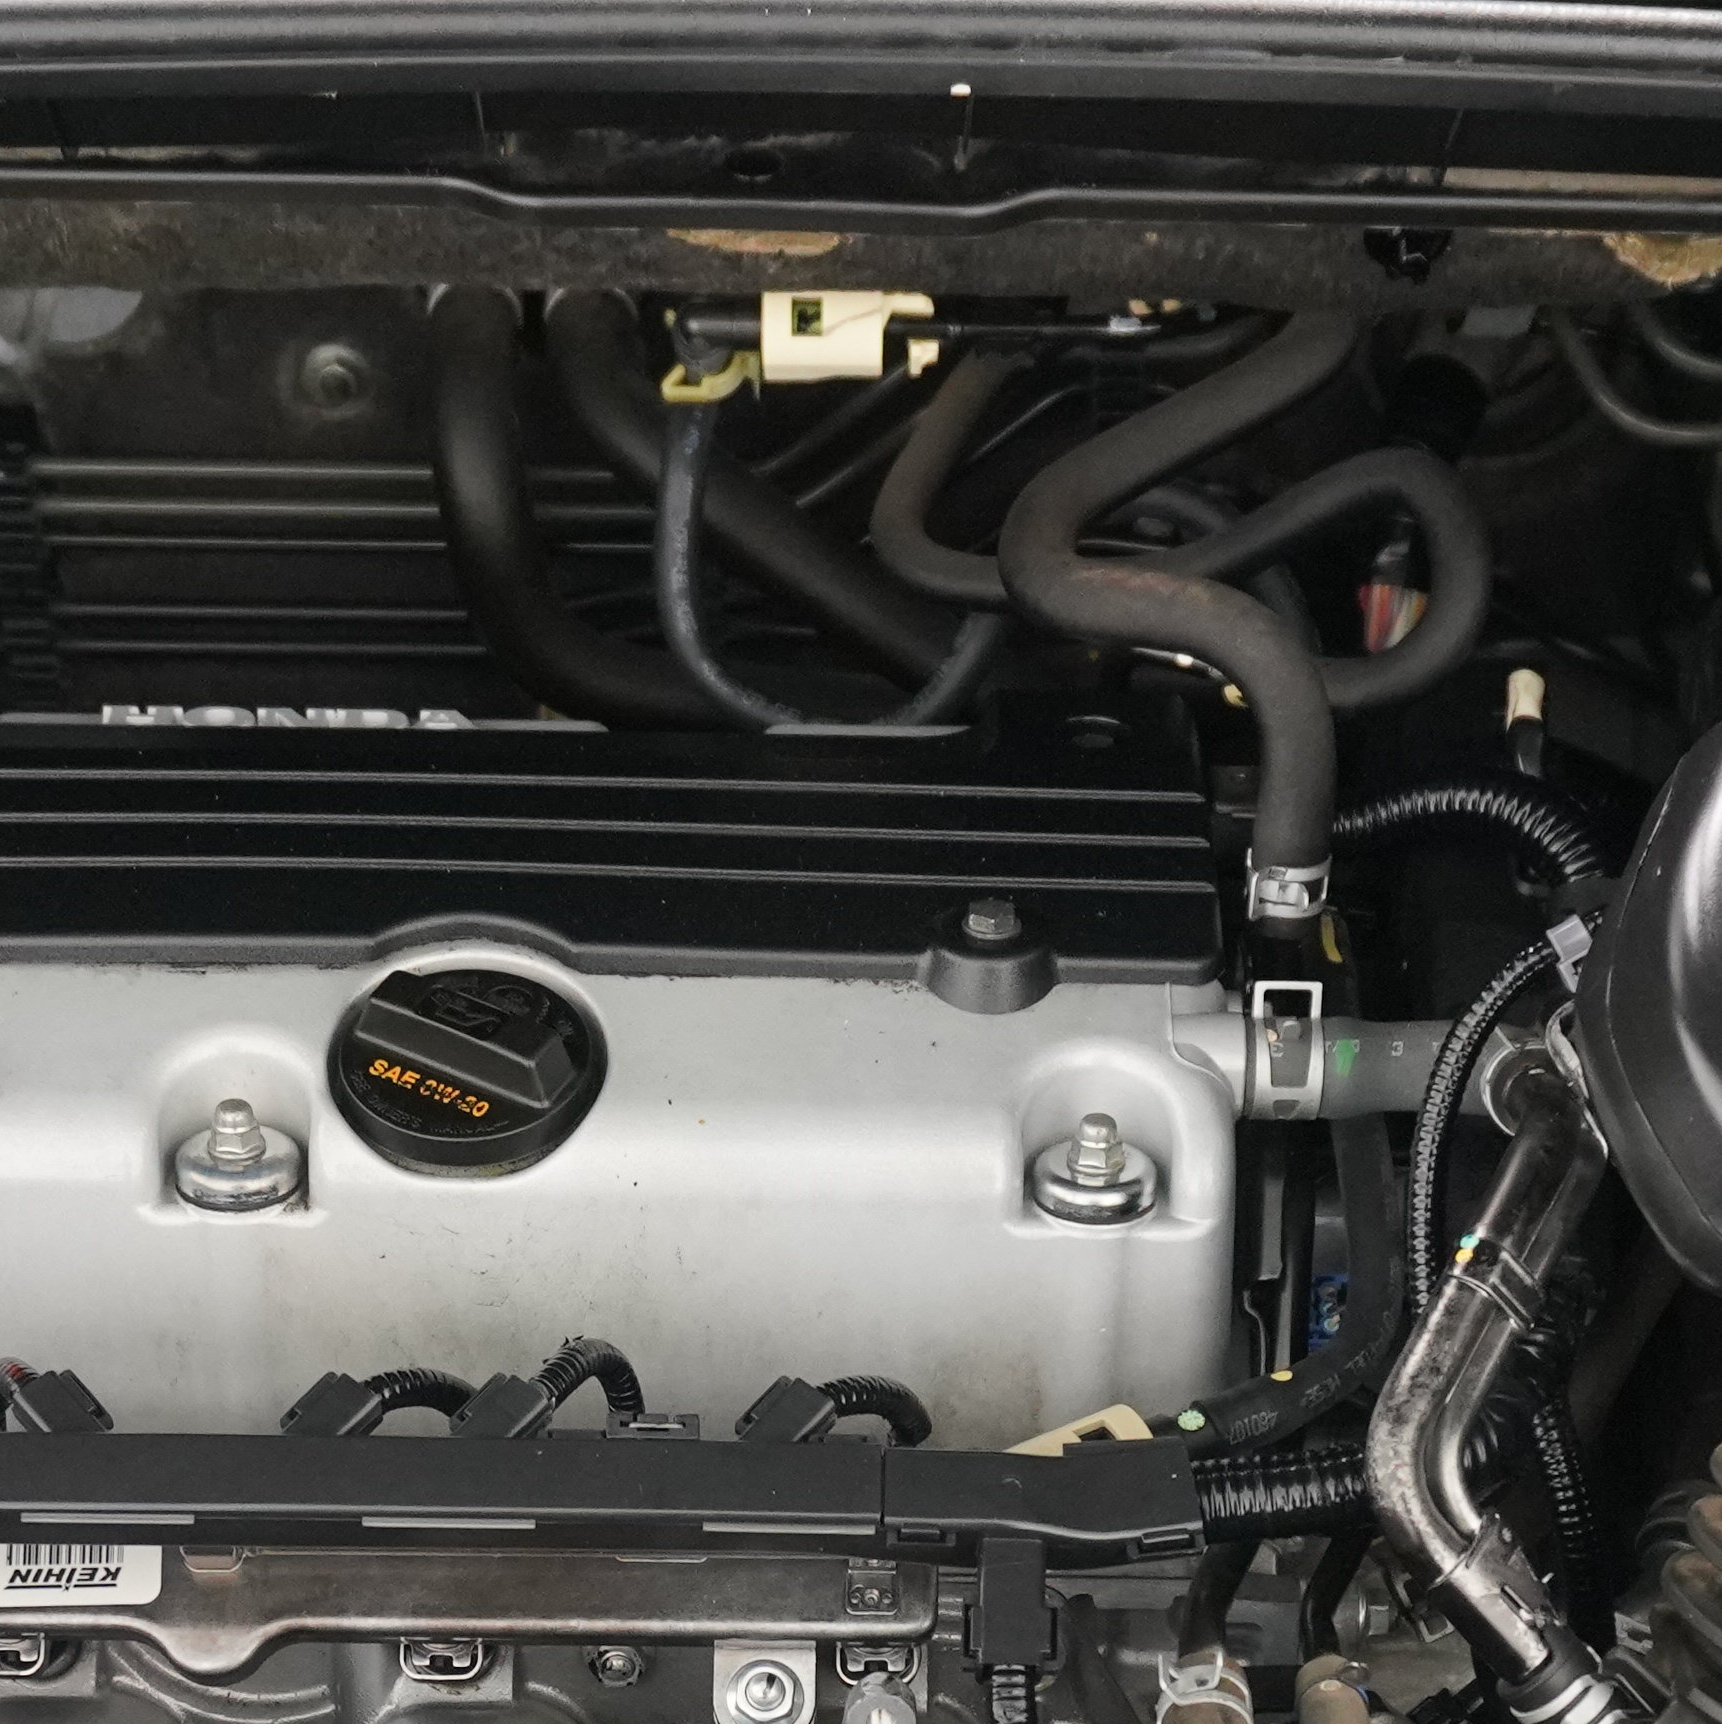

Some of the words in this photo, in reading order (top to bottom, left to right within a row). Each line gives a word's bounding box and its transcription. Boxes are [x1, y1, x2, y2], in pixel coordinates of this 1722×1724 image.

[369, 1059, 421, 1090] SAE
[420, 1079, 489, 1117] 0W-20
[9, 1567, 122, 1584] KEIHIN
